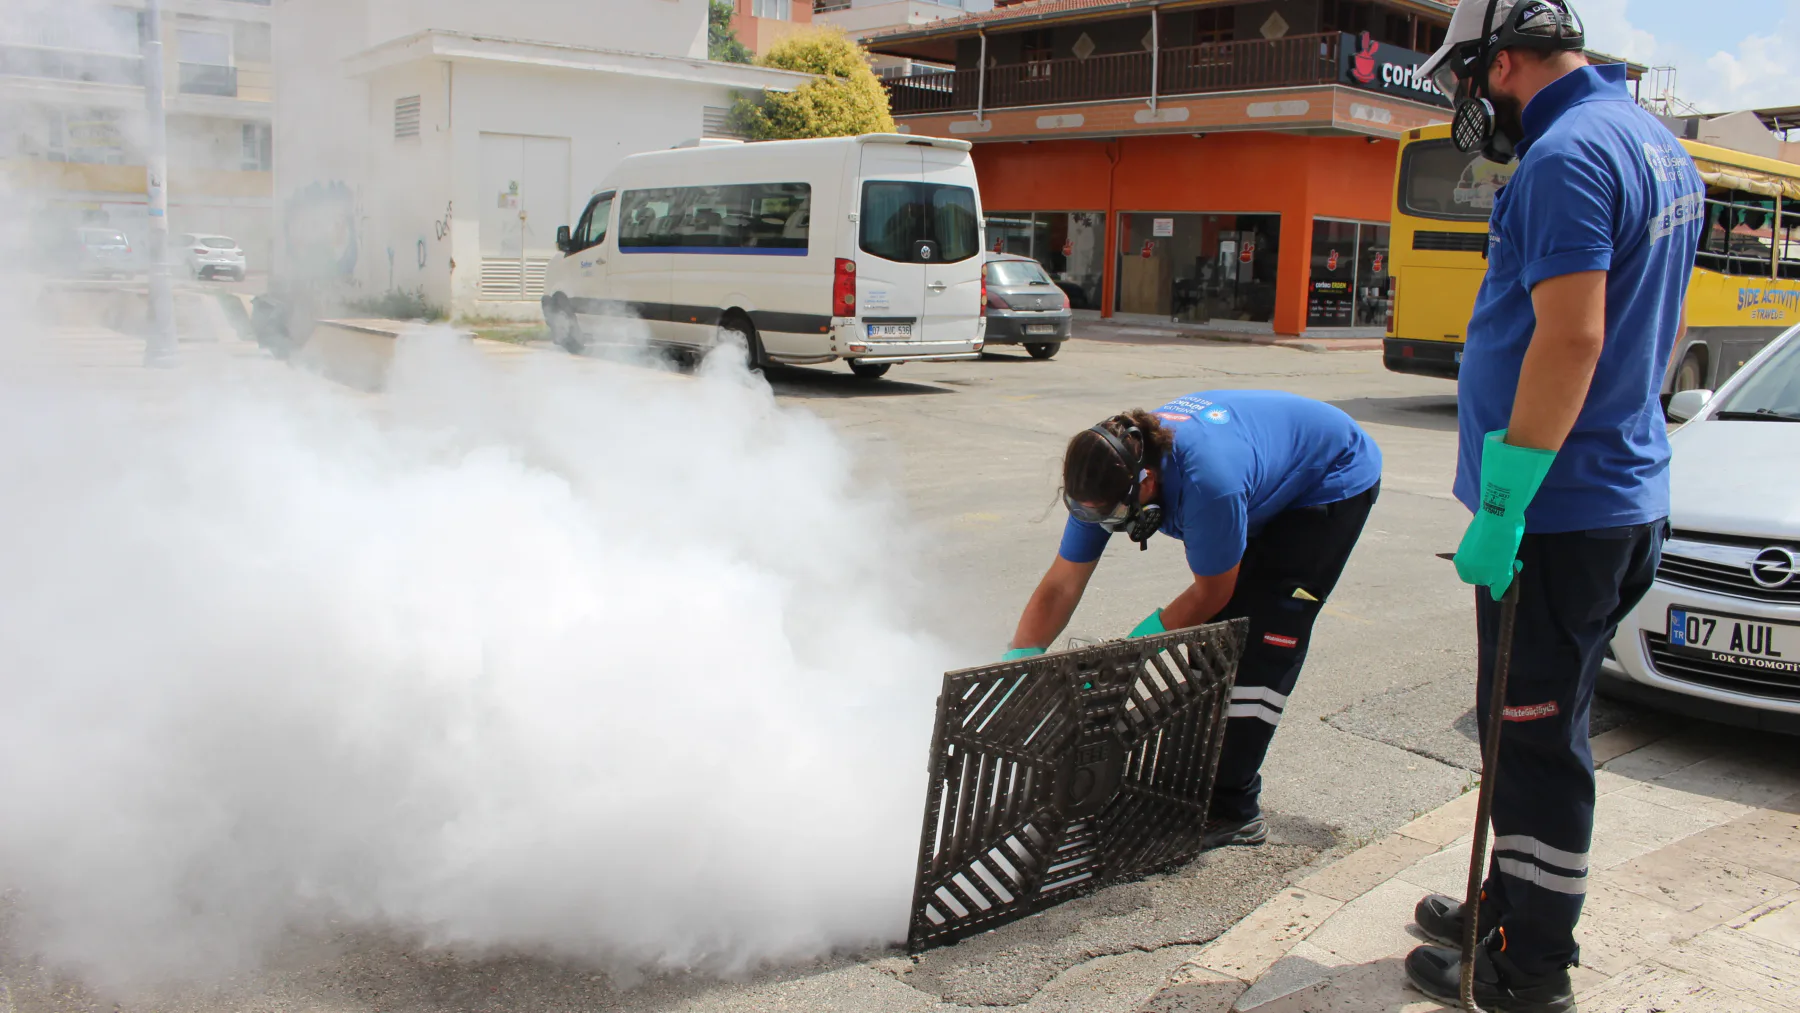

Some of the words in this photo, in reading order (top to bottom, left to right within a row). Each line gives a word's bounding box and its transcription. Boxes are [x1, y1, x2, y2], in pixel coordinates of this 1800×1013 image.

[1737, 288, 1761, 311] SIDE
[872, 326, 880, 335] 07
[1673, 629, 1684, 639] TR
[1686, 616, 1717, 646] 07
[1729, 622, 1782, 657] AUL
[1711, 652, 1736, 664] LOK
[1739, 657, 1800, 672] OTOMOTİ
